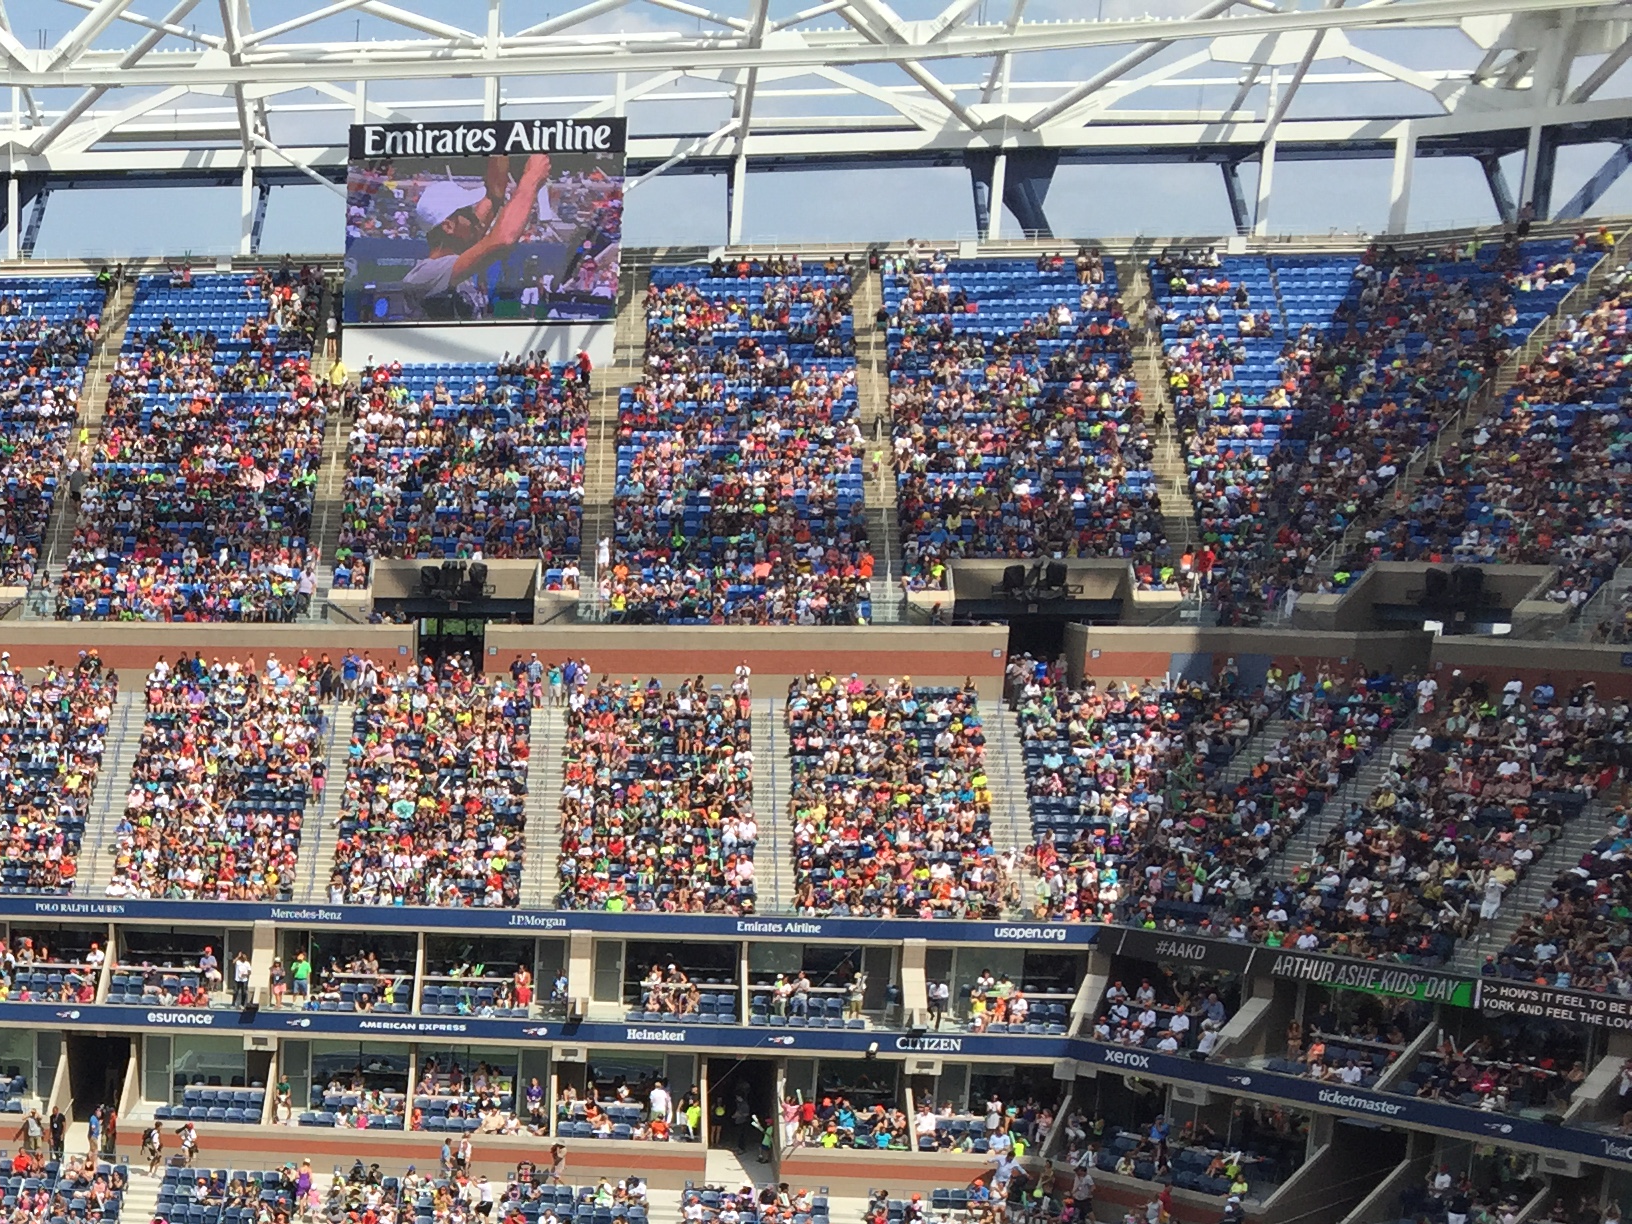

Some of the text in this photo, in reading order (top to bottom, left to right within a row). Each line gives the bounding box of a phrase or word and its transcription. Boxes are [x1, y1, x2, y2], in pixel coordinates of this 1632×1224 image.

[364, 119, 611, 155] Emirates Airline
[35, 902, 125, 914] POLO RALPH LAUREN
[271, 908, 343, 920] Mercedes-Benz
[737, 920, 822, 934] Emirates Airline
[994, 926, 1066, 941] usopen.org
[1155, 940, 1206, 961] #AAKD
[1271, 954, 1460, 1001] ARTHUR ASHE KIDS' DAY
[1499, 986, 1539, 1002] HOW'S
[1541, 991, 1553, 1003] IT
[1555, 993, 1586, 1008] FEEL
[1589, 998, 1607, 1011] TO
[1609, 1002, 1627, 1014] BE
[147, 1010, 213, 1025] esurance
[1482, 997, 1515, 1012] YORK
[1517, 1002, 1544, 1016] AND
[1545, 1006, 1576, 1021] FEEL
[1579, 1011, 1603, 1025] THE
[359, 1020, 467, 1032] AMERICAN EXPRESS
[627, 1028, 686, 1042] Heineken
[896, 1037, 962, 1051] CITIZEN
[1105, 1048, 1150, 1069] xerox
[1319, 1088, 1403, 1116] ticketmaster
